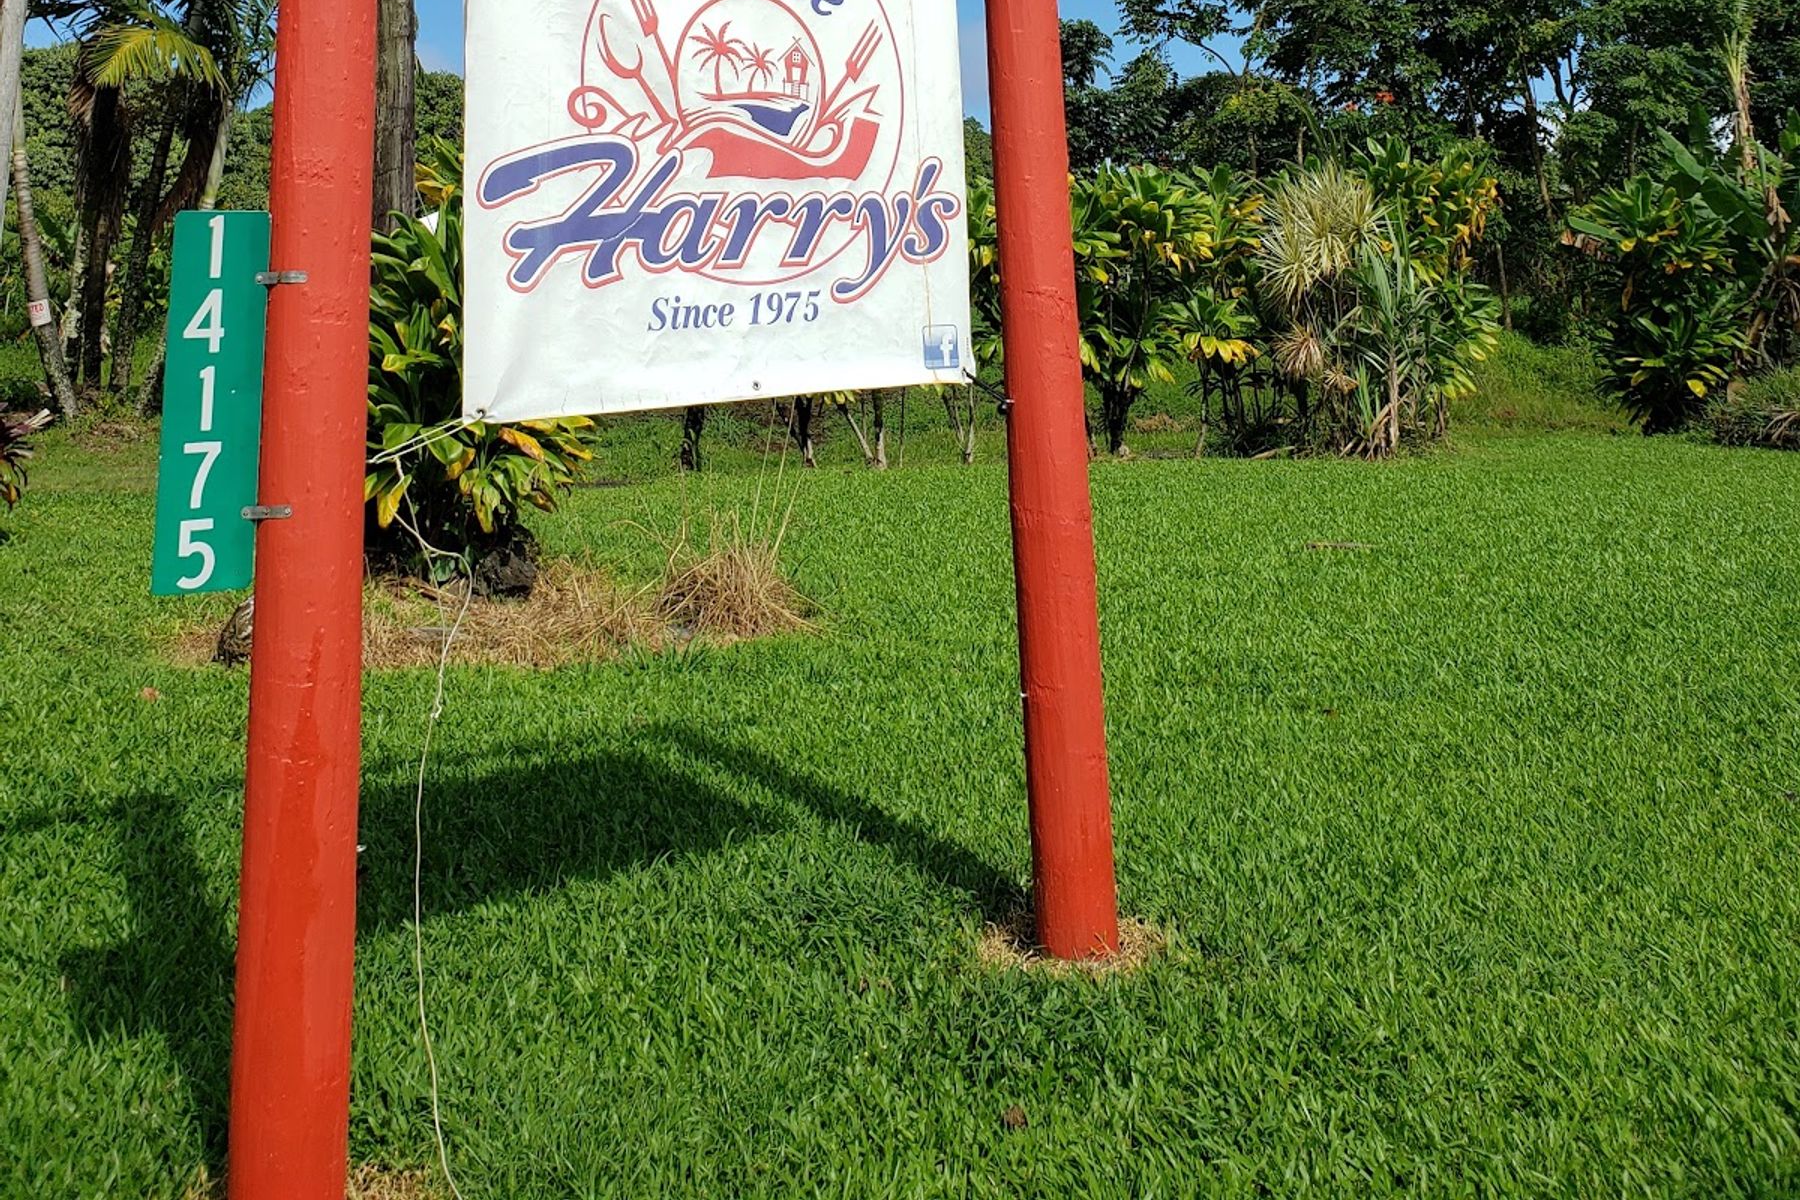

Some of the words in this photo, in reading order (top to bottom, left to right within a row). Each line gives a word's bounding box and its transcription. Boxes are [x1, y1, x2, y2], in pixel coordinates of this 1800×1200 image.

[477, 136, 960, 304] Harry's
[647, 296, 734, 333] Since
[748, 289, 821, 325] 1975
